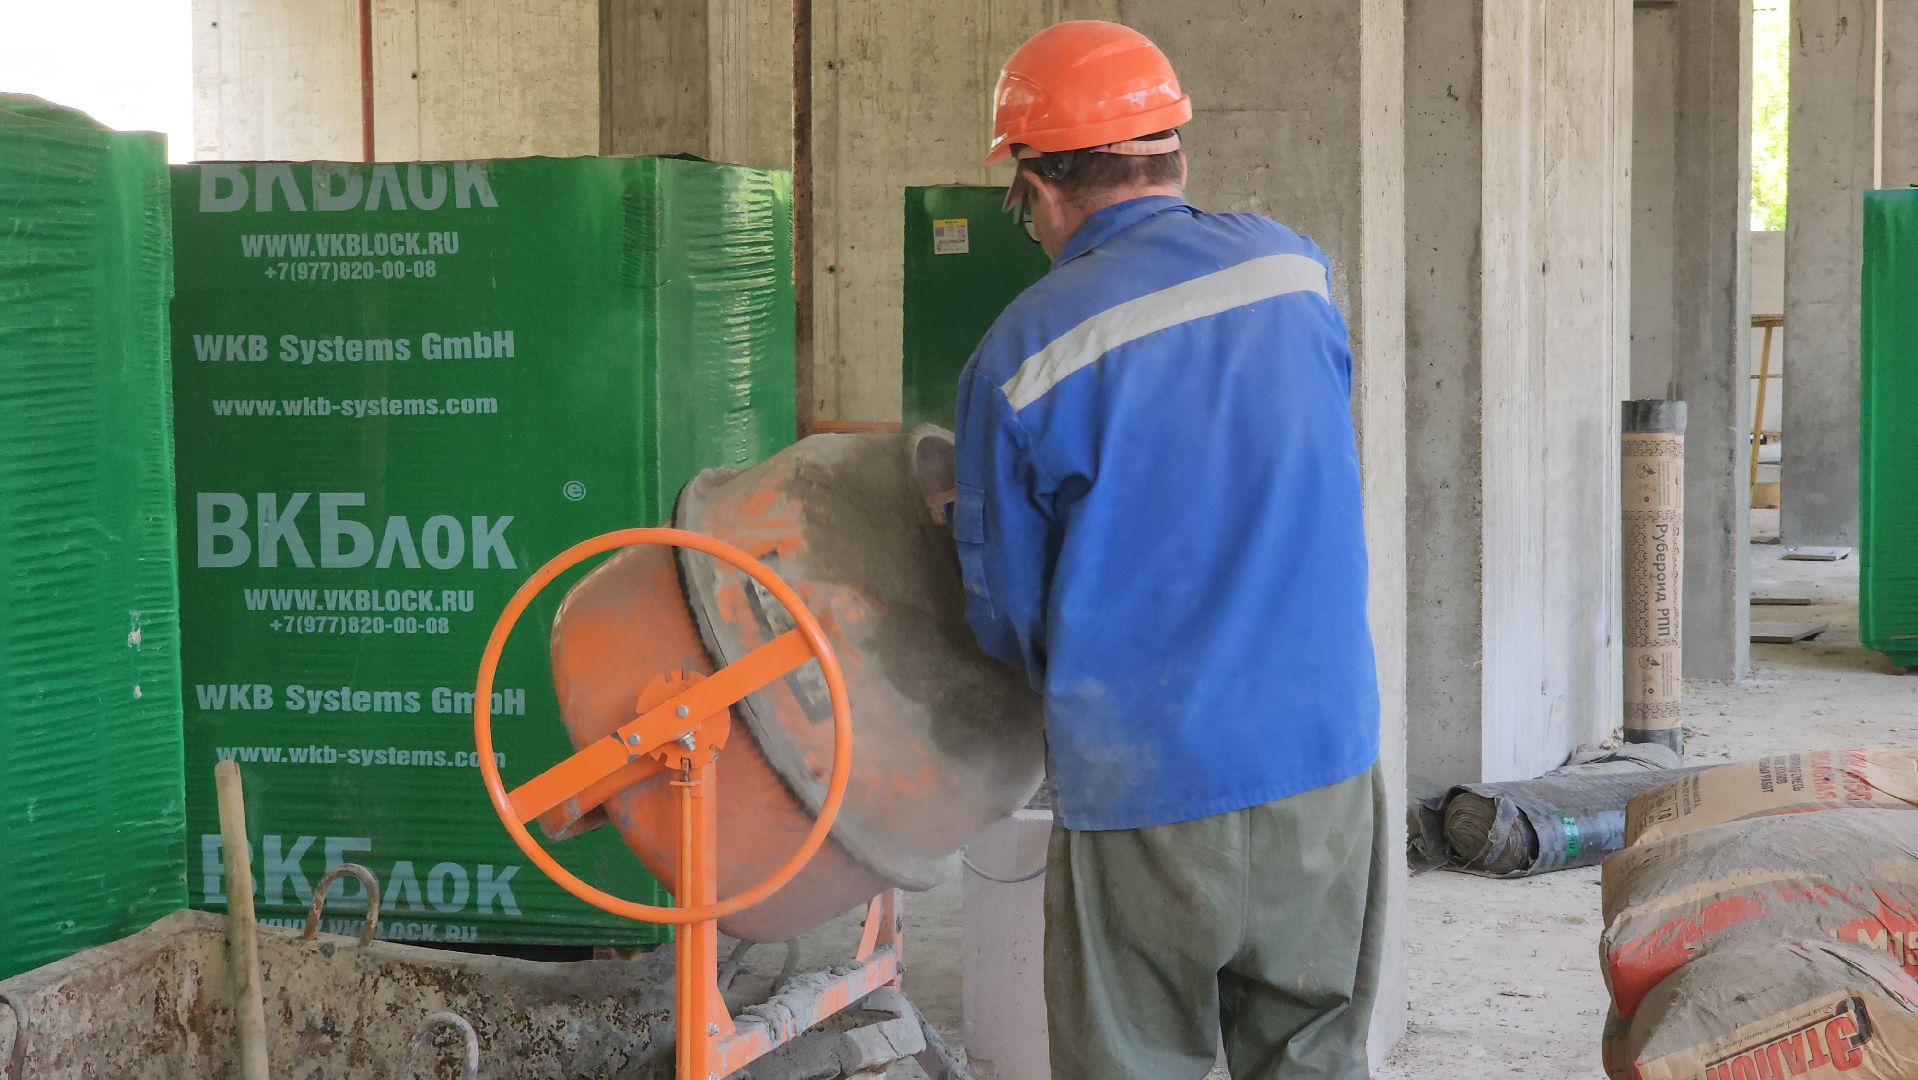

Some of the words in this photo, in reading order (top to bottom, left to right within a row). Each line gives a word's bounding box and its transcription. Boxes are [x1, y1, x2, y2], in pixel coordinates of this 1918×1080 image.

[241, 231, 460, 257] WWW.VKBLOCK.RU
[264, 260, 437, 282] +7(977)820-00-08
[193, 334, 268, 362] WKB
[279, 334, 411, 365] Systems
[421, 330, 515, 360] GmbH
[212, 396, 498, 418] www.wkb-systems.com
[1652, 523, 1669, 602] Рубероид
[244, 588, 475, 613] WWW.VKBLOCK.RU
[269, 616, 449, 635] +7(977)820-00-08
[1657, 608, 1671, 636] РПП
[196, 684, 274, 711] WKB
[286, 684, 421, 715] Systems
